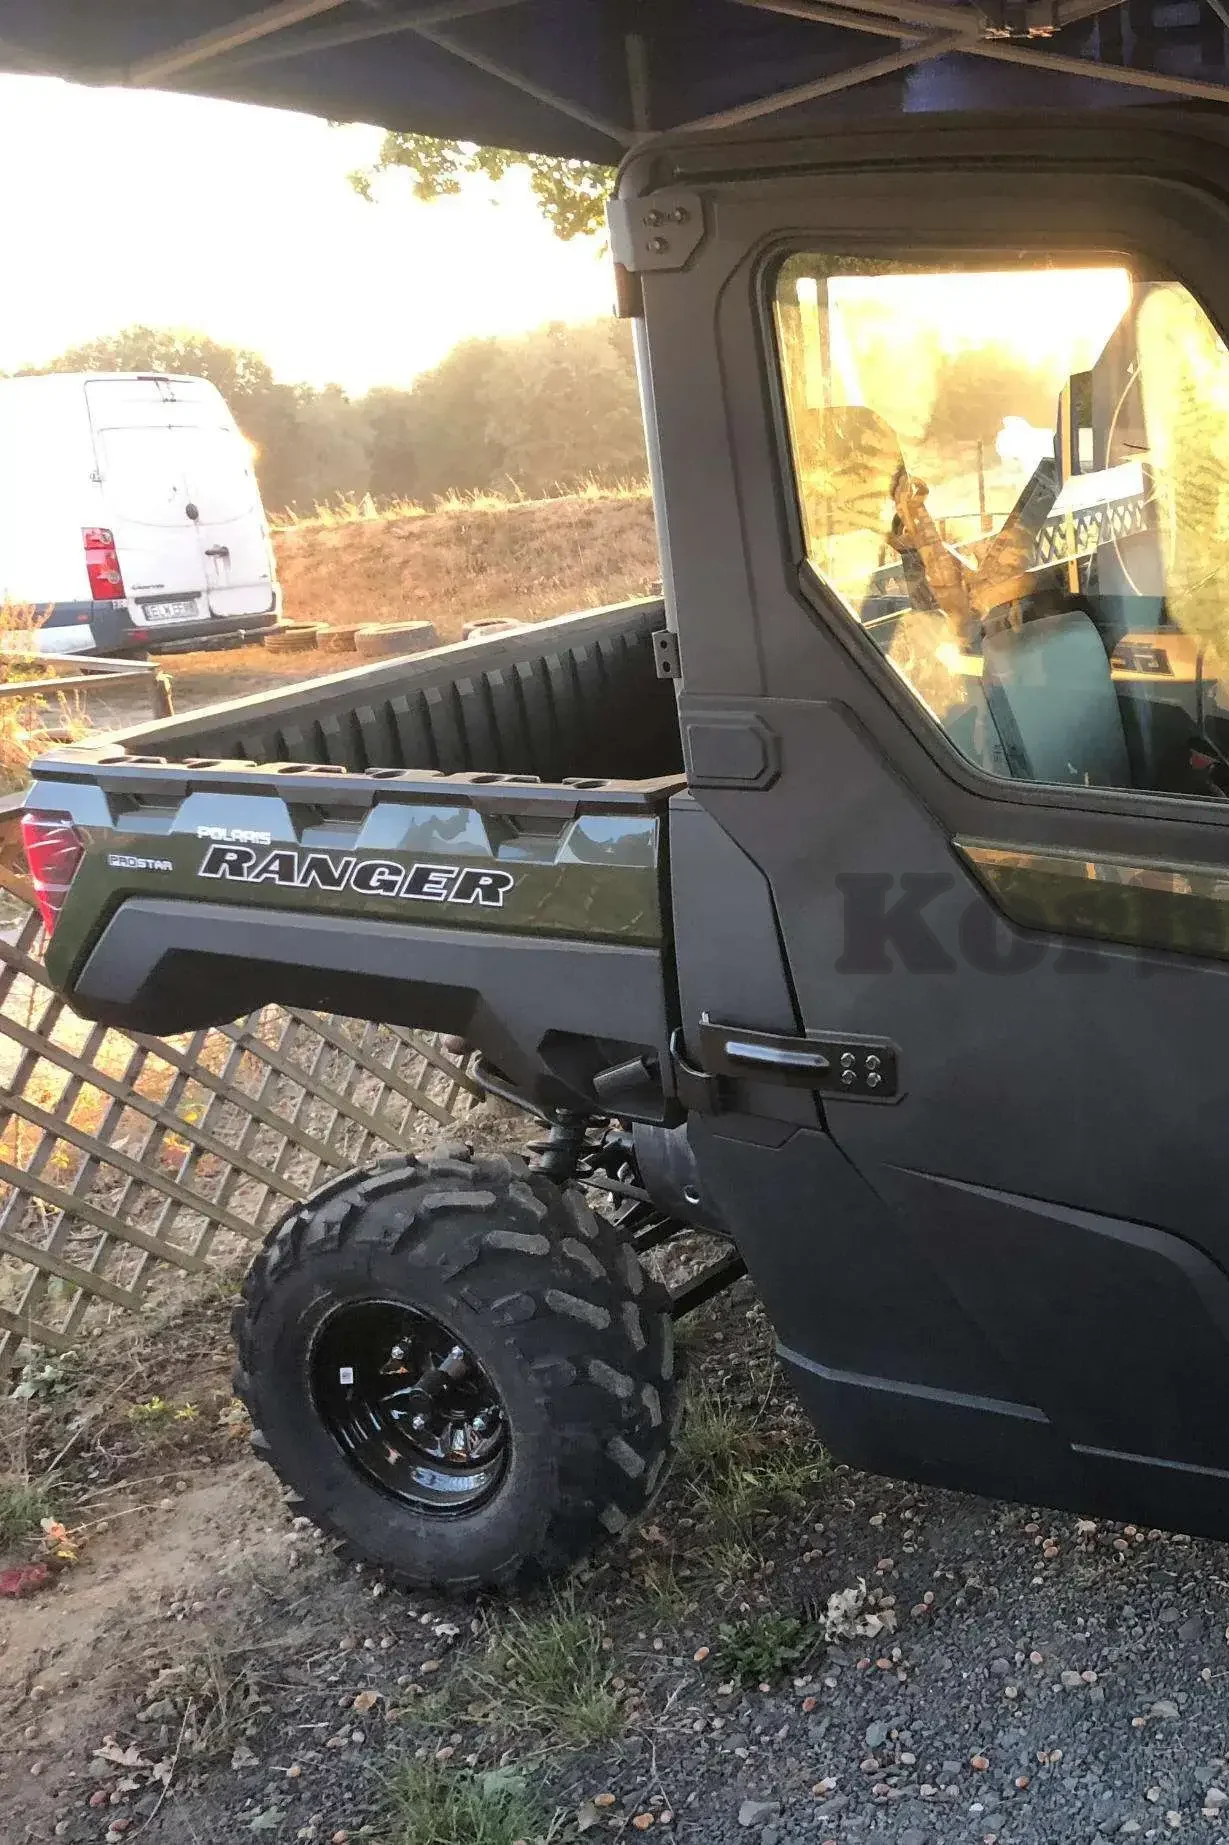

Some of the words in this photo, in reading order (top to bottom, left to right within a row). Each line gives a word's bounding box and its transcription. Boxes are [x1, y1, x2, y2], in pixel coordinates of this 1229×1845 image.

[196, 825, 273, 845] POLARIS
[108, 854, 173, 871] PROSTAR
[198, 843, 514, 907] RANGER
